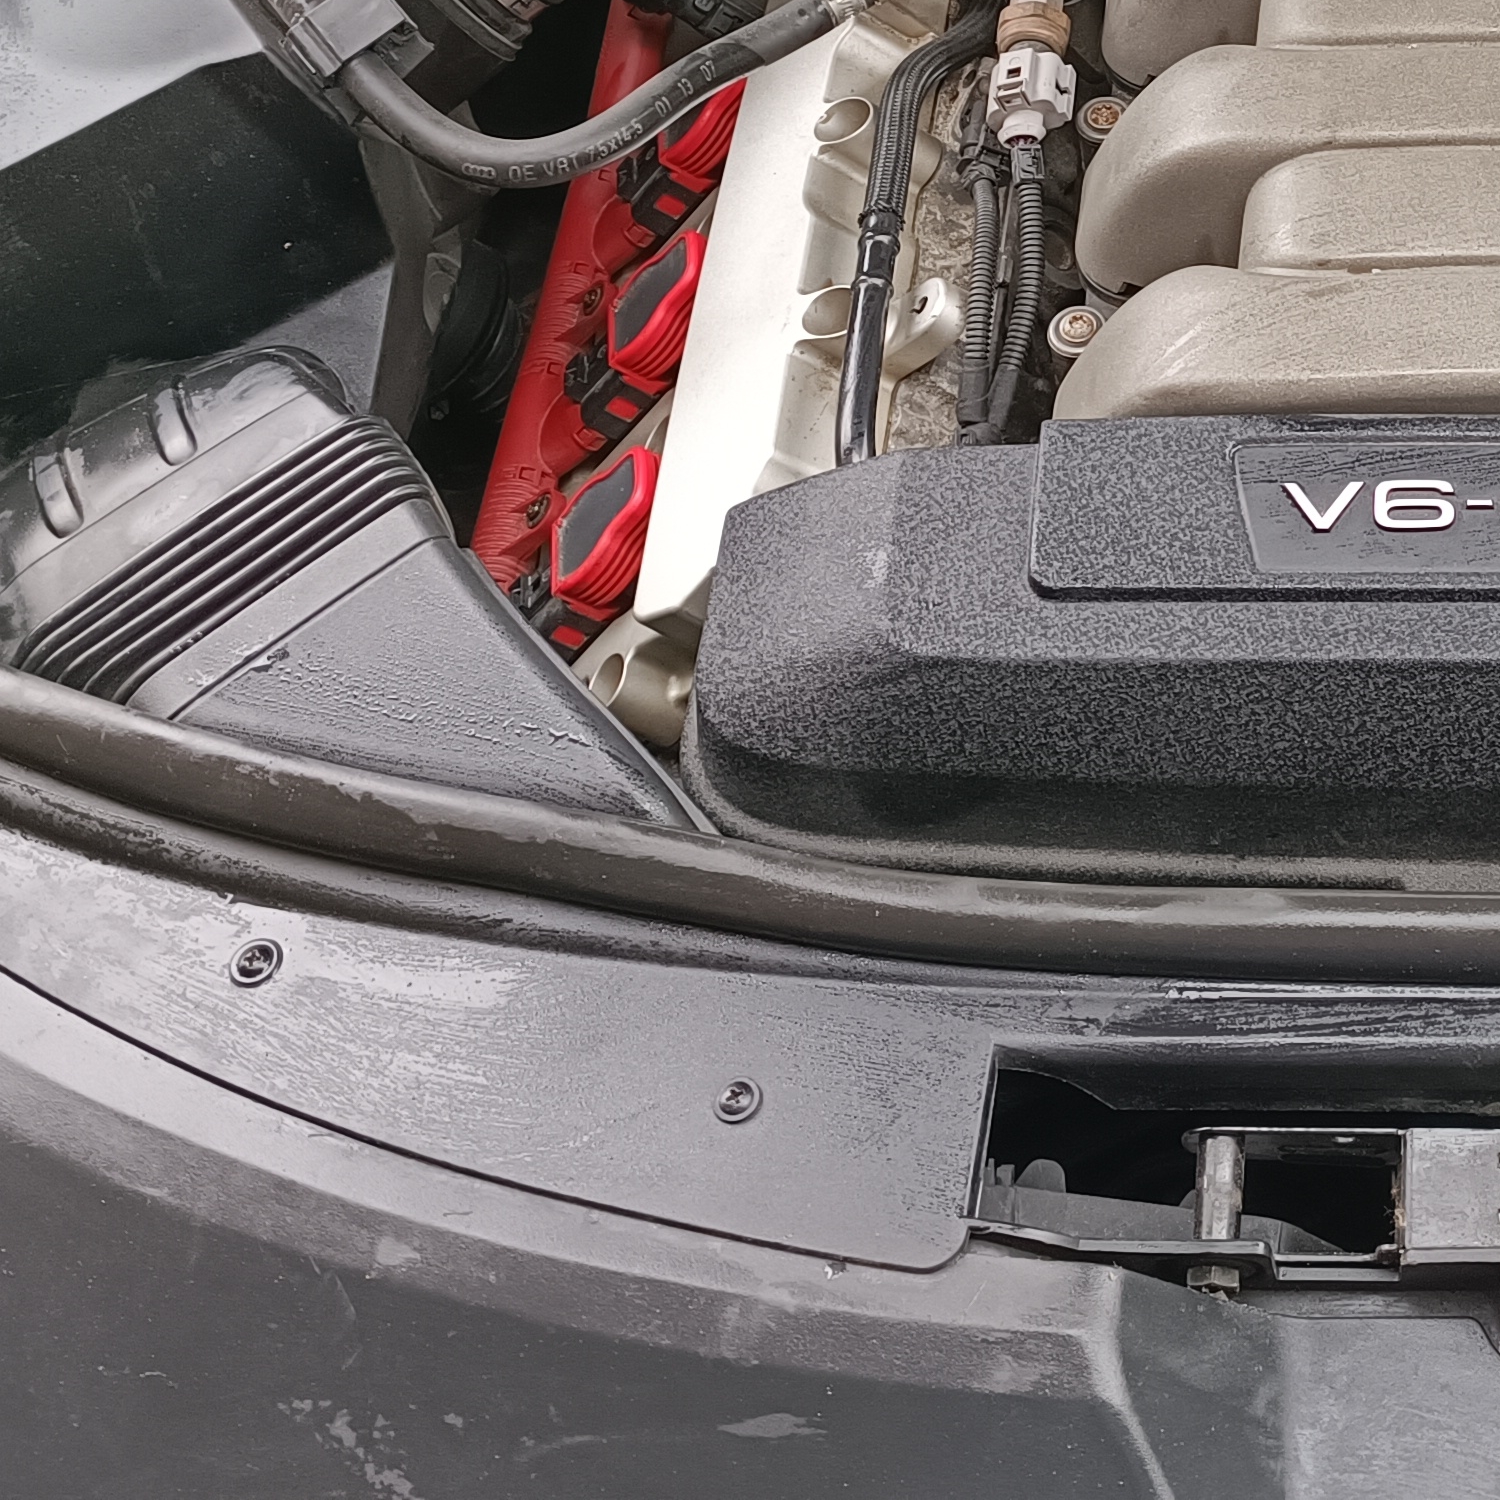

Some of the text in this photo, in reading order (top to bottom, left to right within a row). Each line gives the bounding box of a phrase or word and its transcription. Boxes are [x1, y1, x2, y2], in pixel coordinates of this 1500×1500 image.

[508, 164, 537, 182] OE
[654, 96, 672, 118] 01
[677, 78, 695, 98] 13
[699, 59, 717, 83] 07
